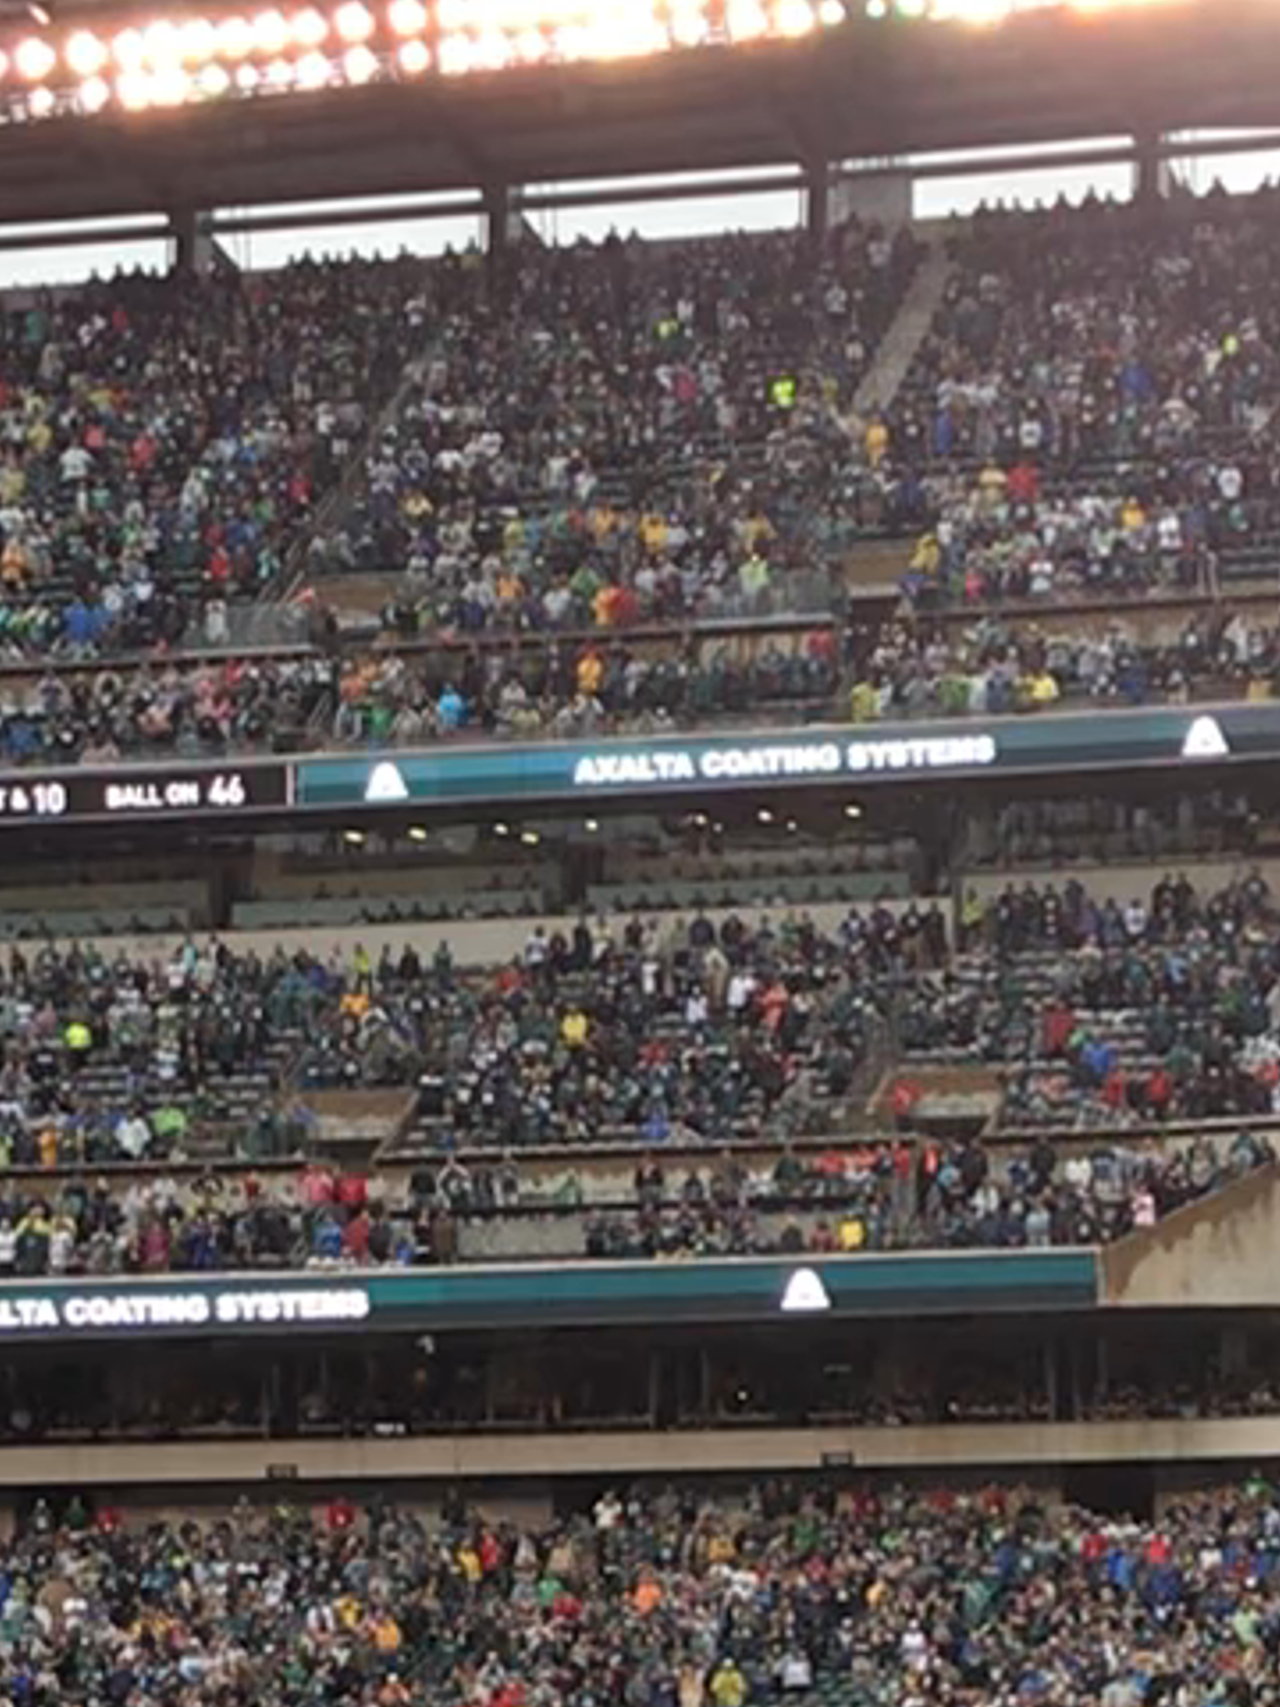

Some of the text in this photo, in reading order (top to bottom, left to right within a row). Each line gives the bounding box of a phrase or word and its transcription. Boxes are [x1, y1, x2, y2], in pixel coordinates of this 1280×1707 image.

[574, 735, 996, 785] AXALTA COATING SYSTEMS
[33, 783, 66, 815] 10
[105, 774, 245, 808] BALL ON 46
[64, 1294, 210, 1326] COATING
[215, 1289, 370, 1321] SYSTEMS
